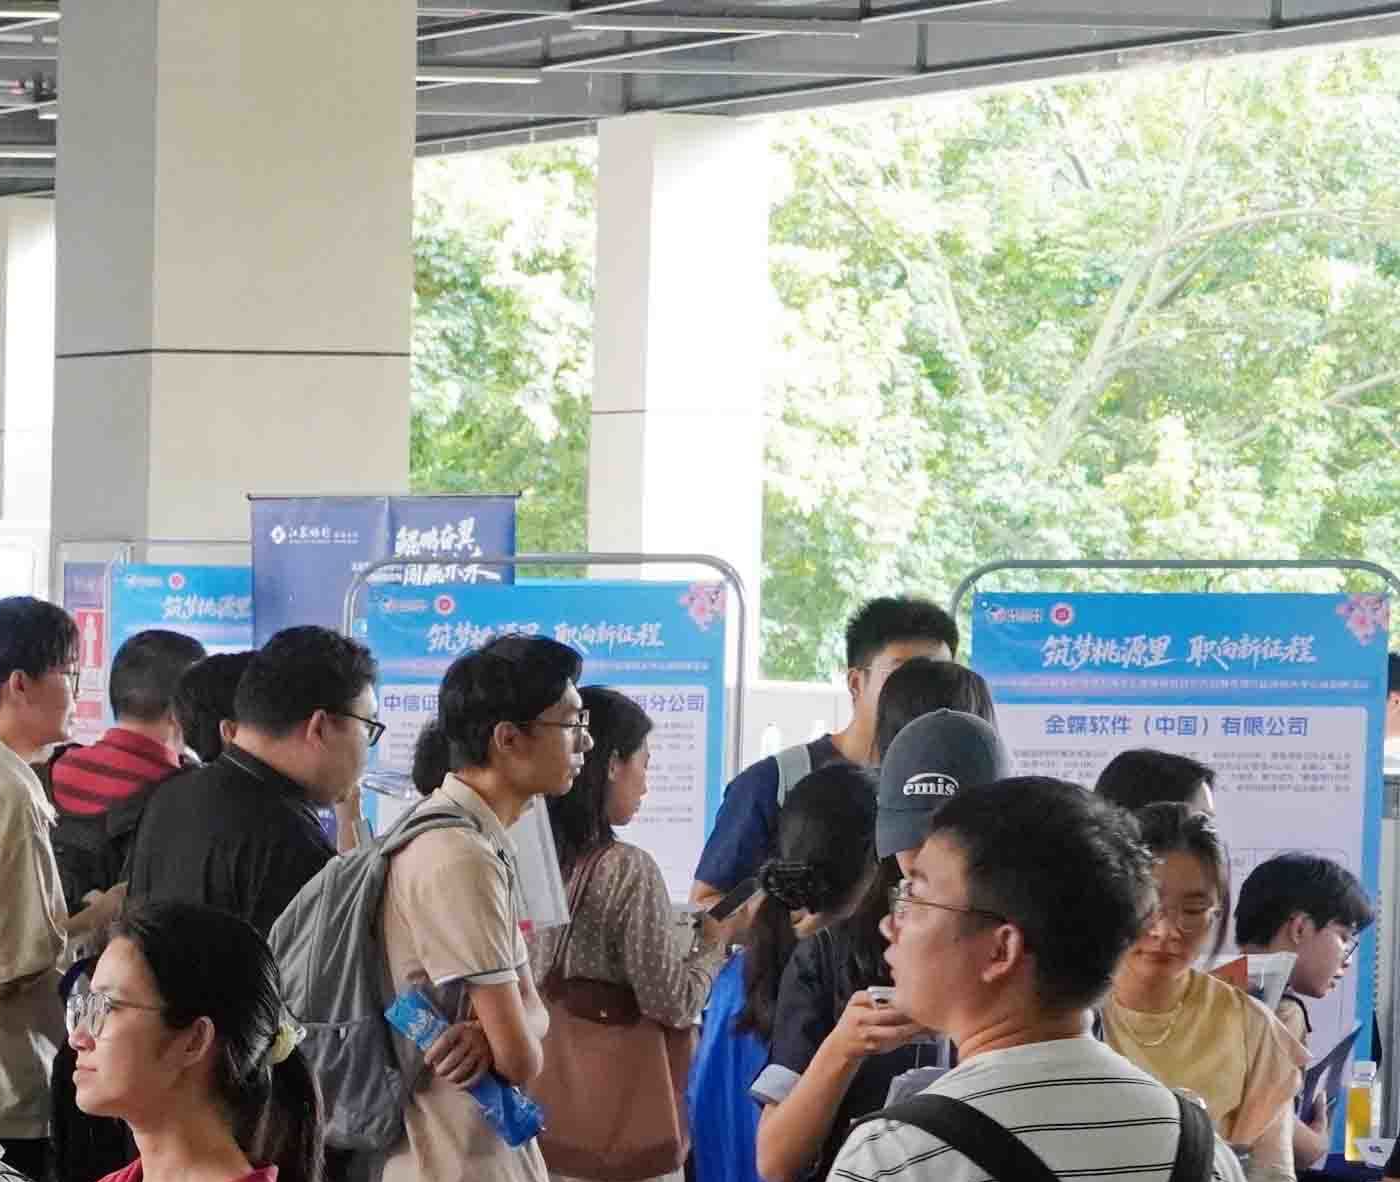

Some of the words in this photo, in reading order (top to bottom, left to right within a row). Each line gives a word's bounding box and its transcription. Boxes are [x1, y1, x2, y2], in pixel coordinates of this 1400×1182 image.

[1040, 634, 1175, 672] 筑梦桃源里
[1185, 634, 1317, 672] 职向新征程
[903, 777, 957, 797] emis
